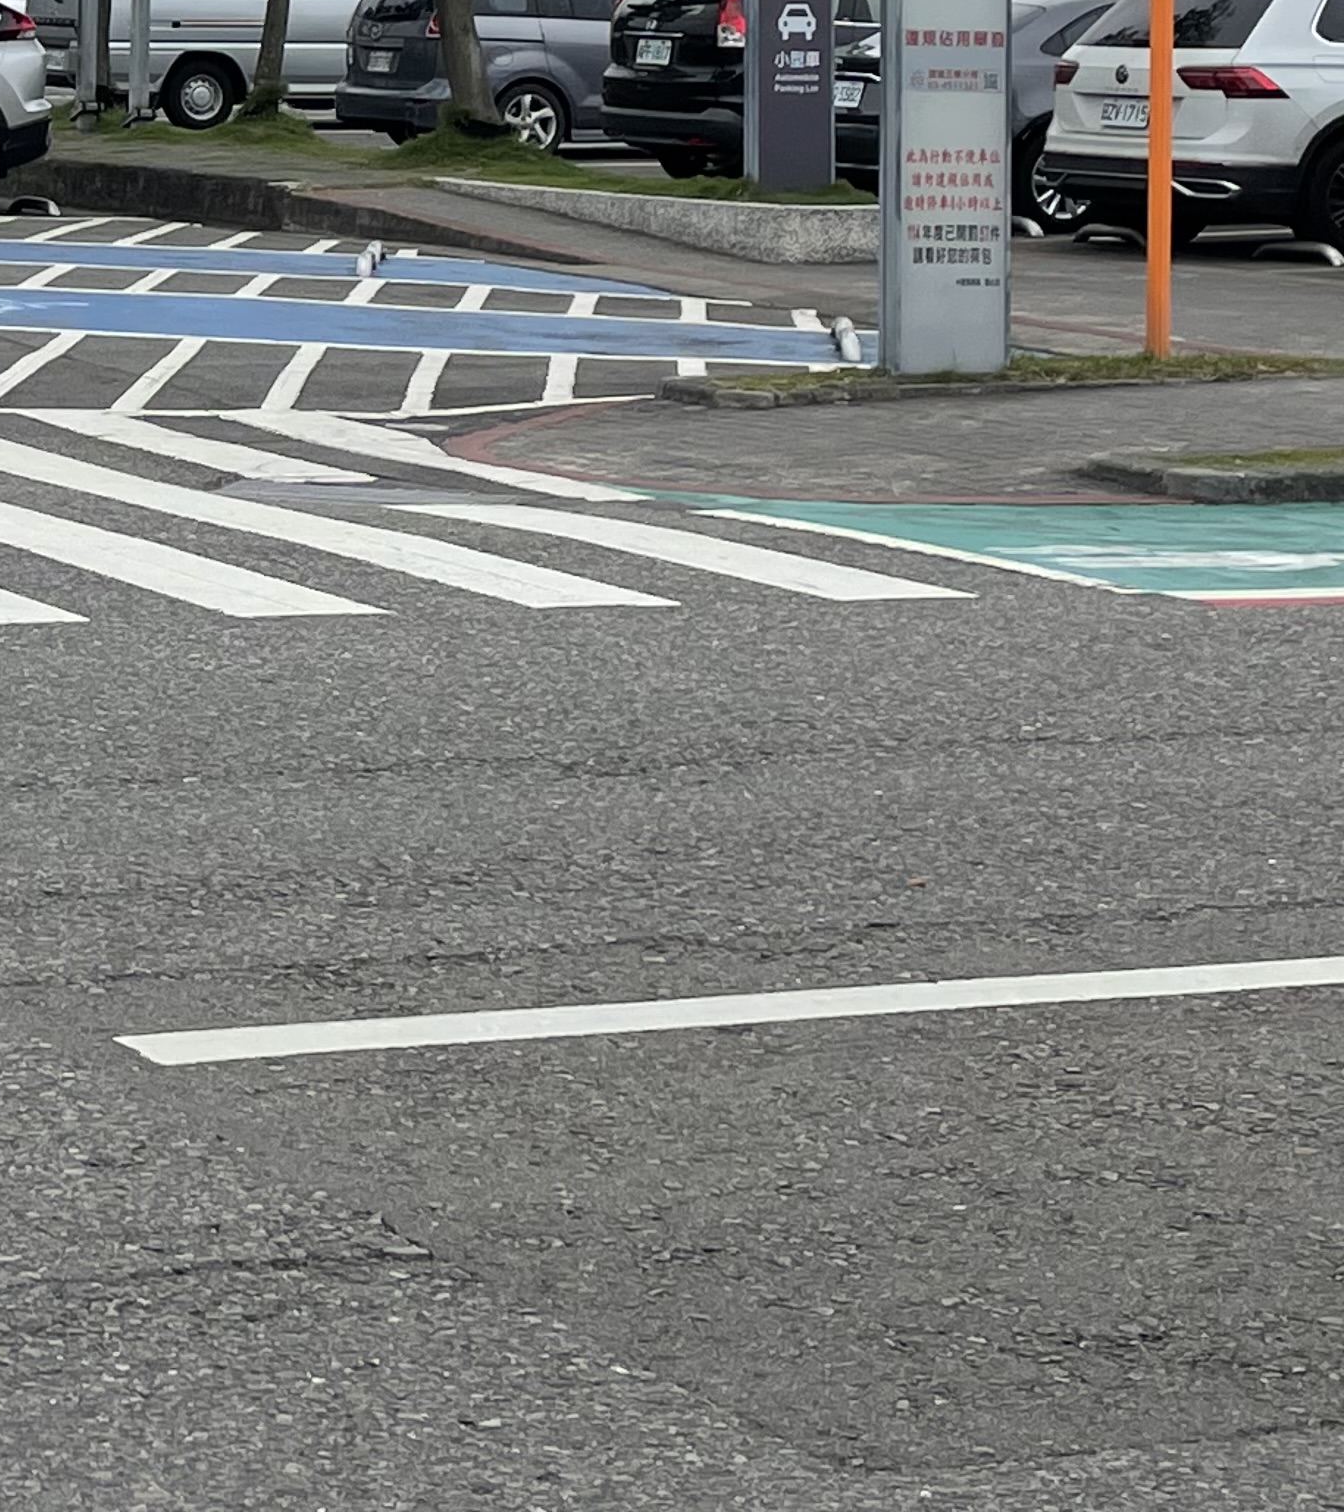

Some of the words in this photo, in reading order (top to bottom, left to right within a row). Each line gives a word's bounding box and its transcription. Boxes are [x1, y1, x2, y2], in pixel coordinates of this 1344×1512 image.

[774, 50, 820, 68] 小型車
[905, 148, 1001, 165] 此為行動不便車位
